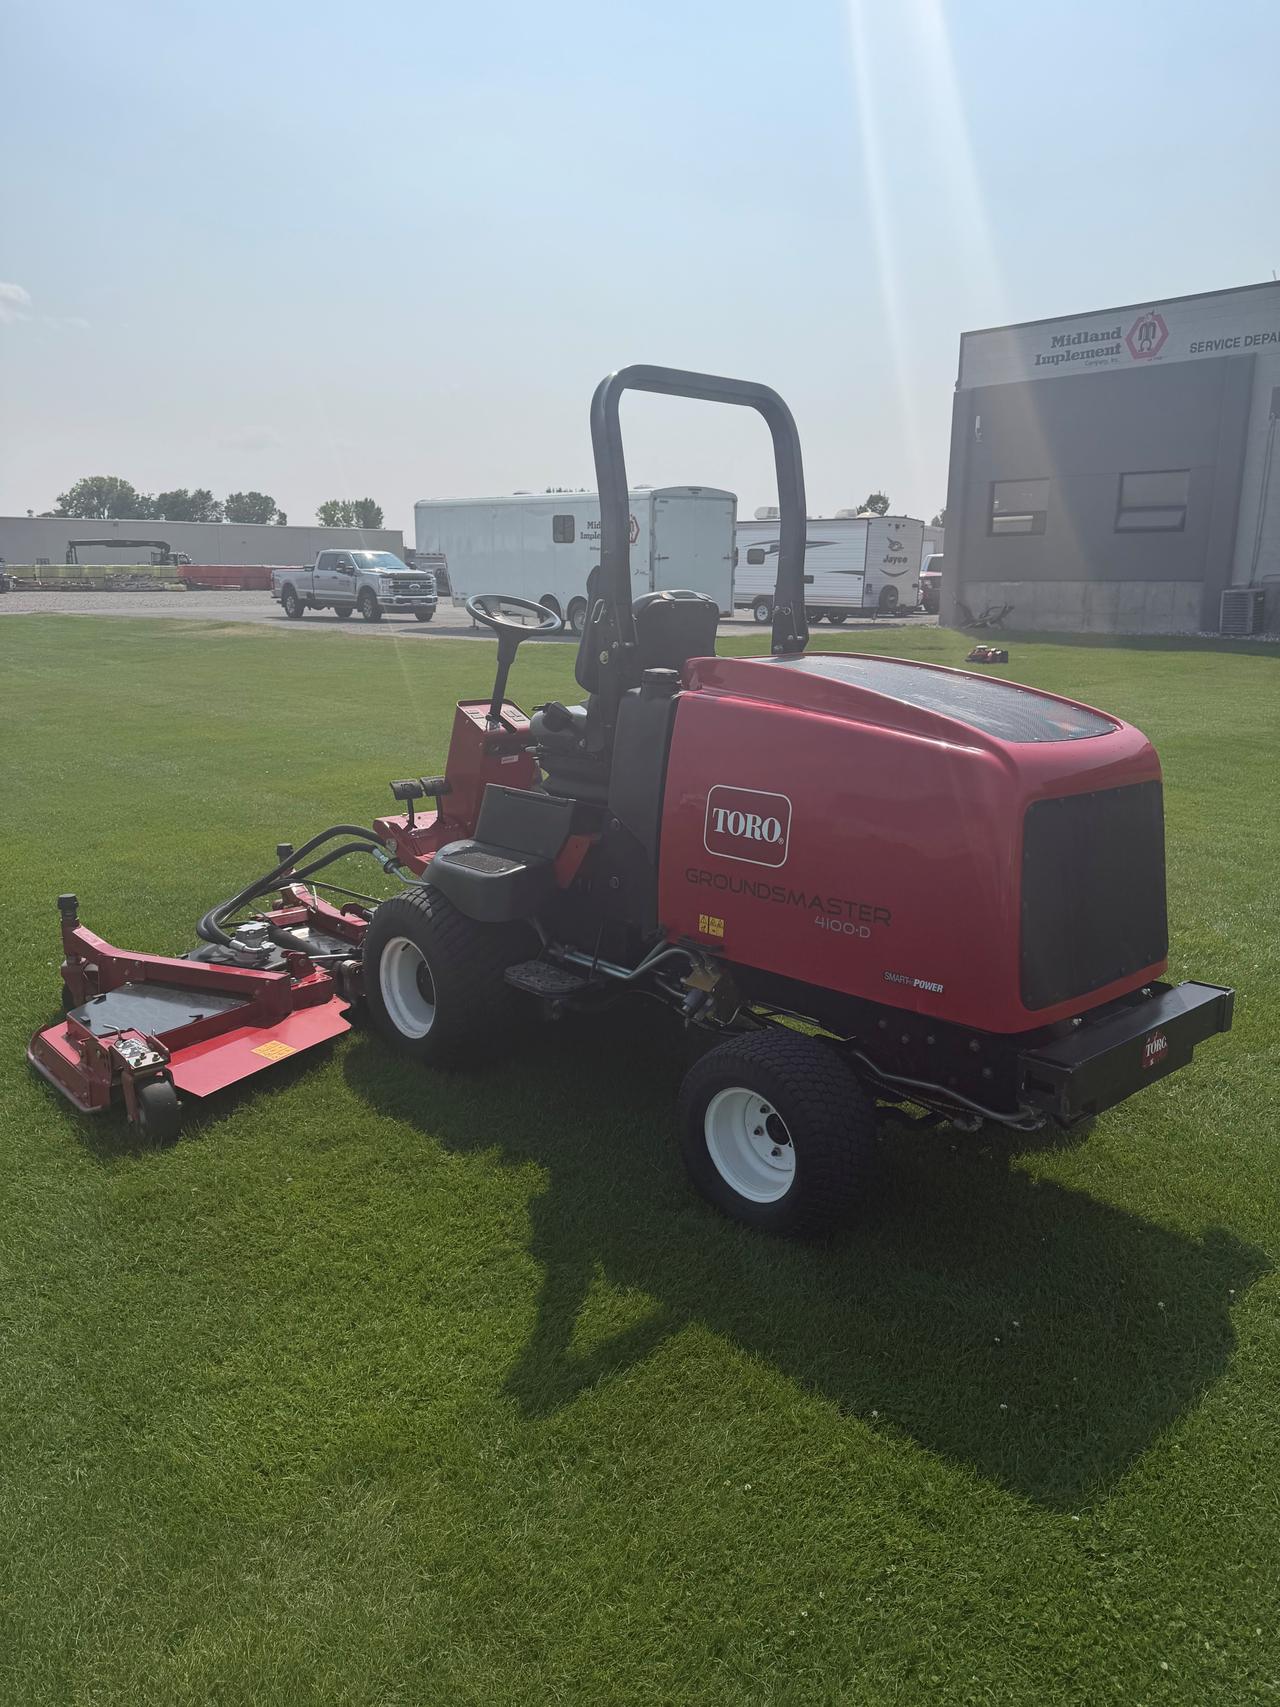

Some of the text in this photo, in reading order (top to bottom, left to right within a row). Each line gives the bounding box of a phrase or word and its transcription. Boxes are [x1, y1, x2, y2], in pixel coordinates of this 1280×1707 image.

[1050, 326, 1122, 348] Midland
[1189, 336, 1241, 353] SERVICE
[1034, 342, 1122, 366] Implement
[587, 521, 601, 530] Mid
[580, 531, 601, 540] Imple
[883, 554, 908, 565] Jayco
[685, 867, 892, 927] GROUNDSMASTER
